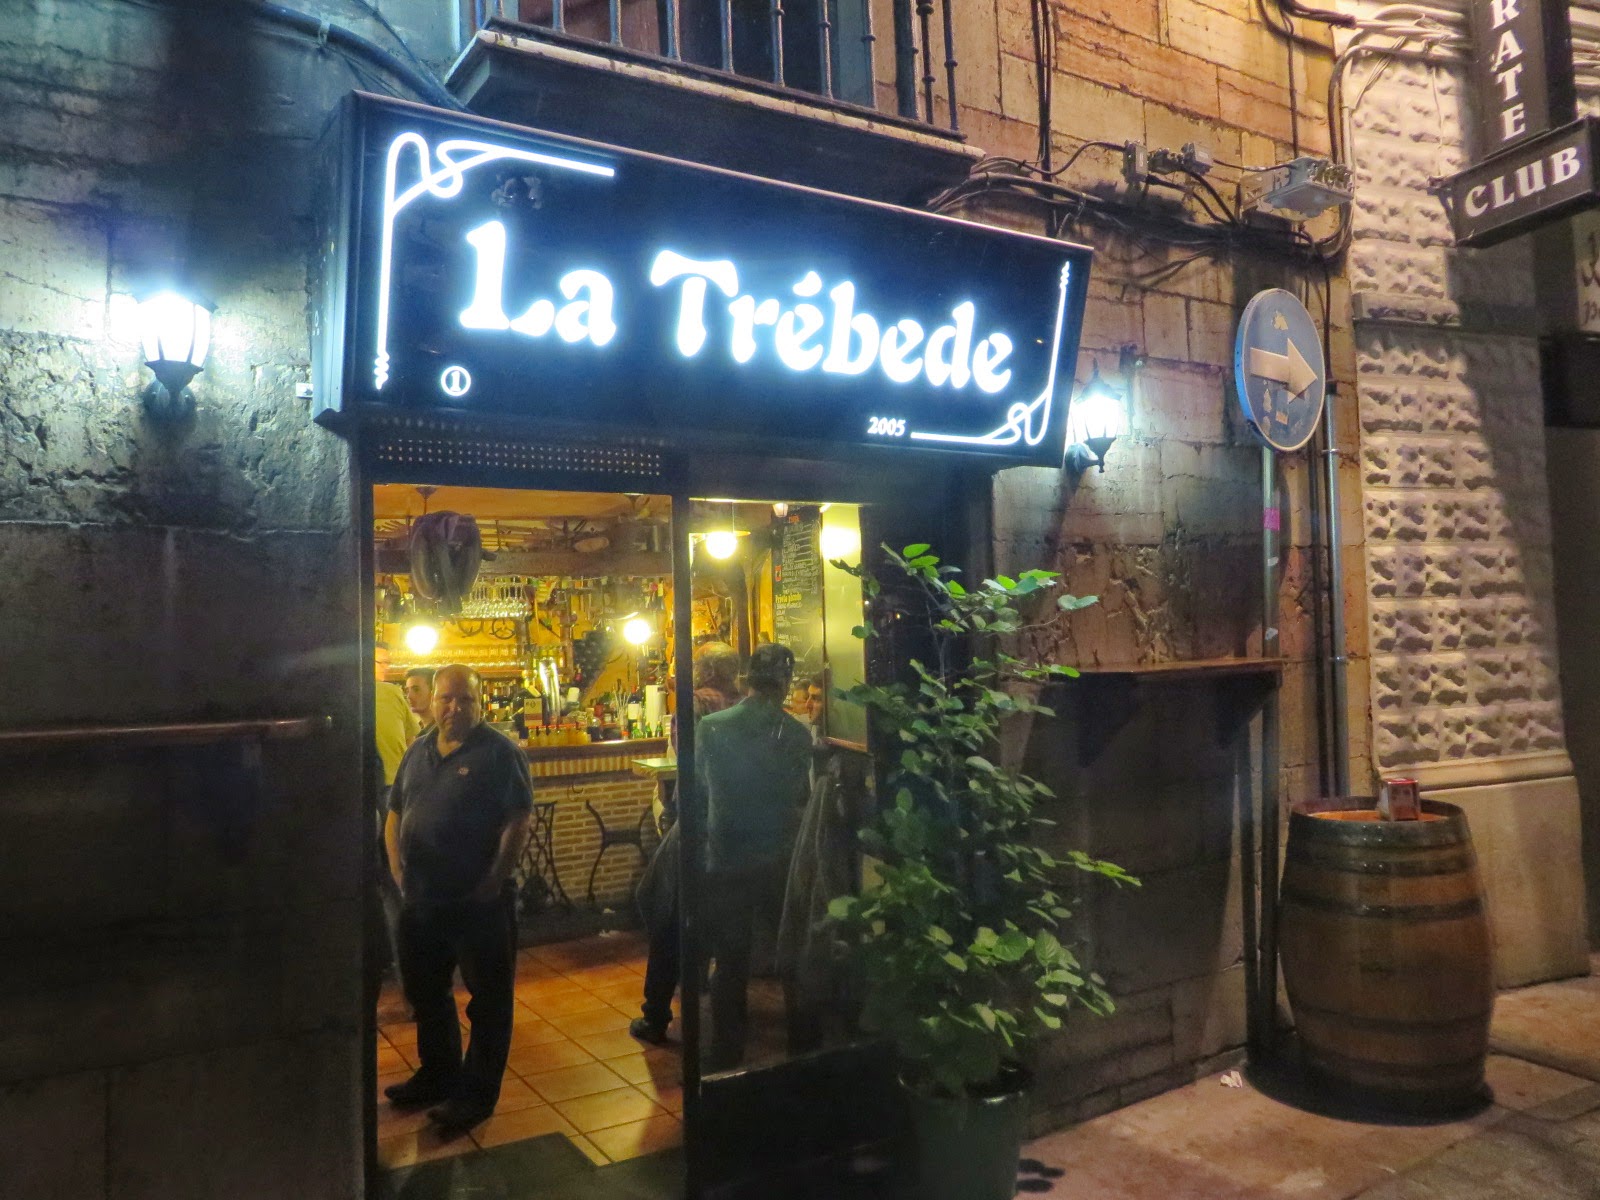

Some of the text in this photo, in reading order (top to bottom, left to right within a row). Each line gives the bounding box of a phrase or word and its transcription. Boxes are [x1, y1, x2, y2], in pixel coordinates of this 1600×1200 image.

[1465, 146, 1582, 218] CLUB
[459, 220, 1013, 394] La Trébede
[867, 416, 906, 437] 2005
